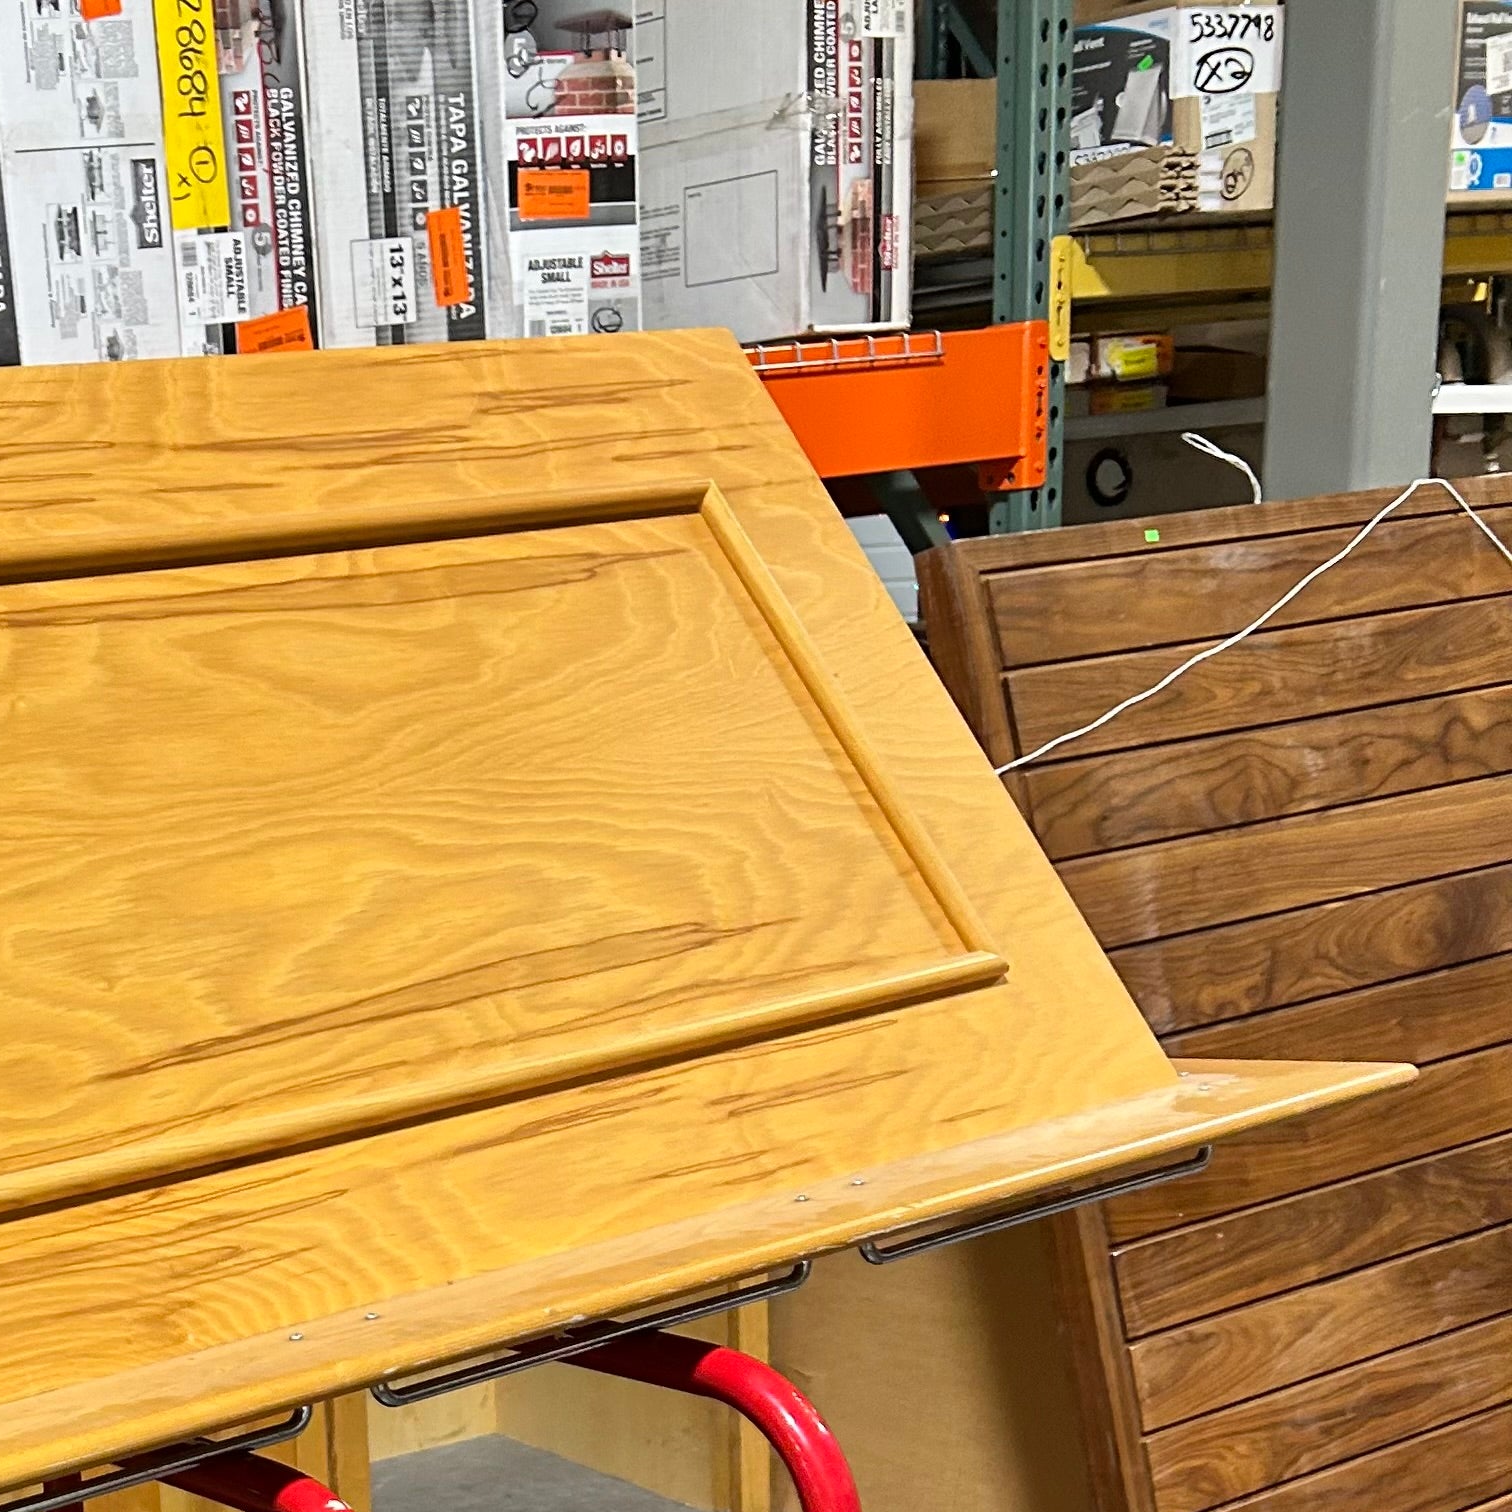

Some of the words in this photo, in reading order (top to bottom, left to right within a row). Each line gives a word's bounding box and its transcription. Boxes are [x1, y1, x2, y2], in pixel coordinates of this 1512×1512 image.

[812, 0, 826, 64] CHIMNE
[266, 88, 282, 138] BLACK
[279, 87, 301, 195] GALVANIZED
[447, 92, 468, 154] TAPA
[141, 162, 160, 244] Shelter
[271, 141, 286, 206] POWDER
[275, 208, 291, 268] COATED
[288, 198, 308, 278] CHIMNEY
[528, 256, 584, 271] ADJUSTABLE
[223, 256, 236, 298] SMALL
[232, 238, 247, 314] ADJUSTABLE
[280, 269, 294, 308] FINIS
[292, 282, 308, 306] CA
[540, 271, 572, 284] SMALL
